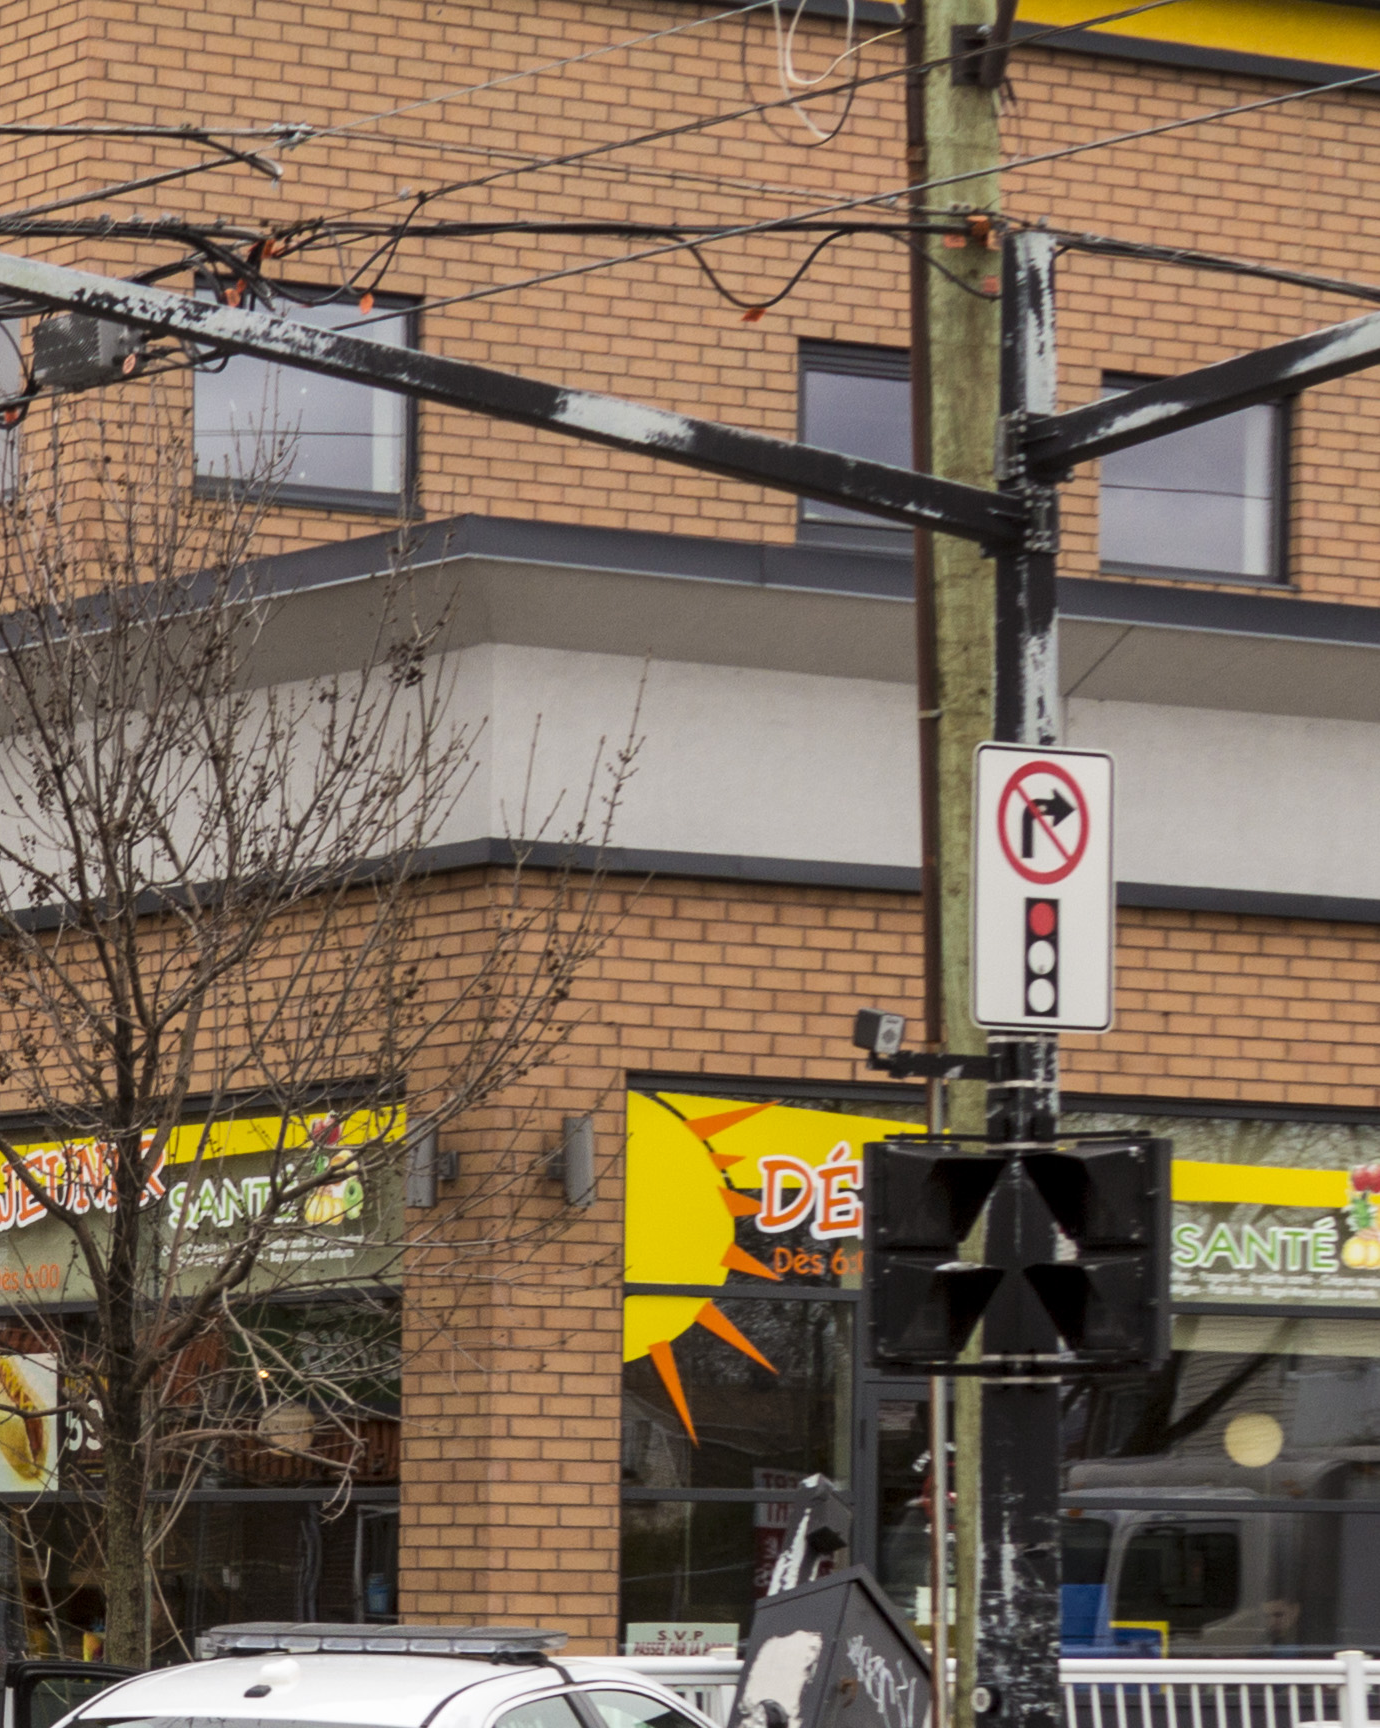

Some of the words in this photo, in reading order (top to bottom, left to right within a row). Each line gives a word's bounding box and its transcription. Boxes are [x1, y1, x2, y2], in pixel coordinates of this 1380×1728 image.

[1170, 1216, 1339, 1272] SANTÉ
[773, 1247, 824, 1275] Dès
[24, 1263, 60, 1289] 6:00
[657, 1630, 704, 1641] S.V.P
